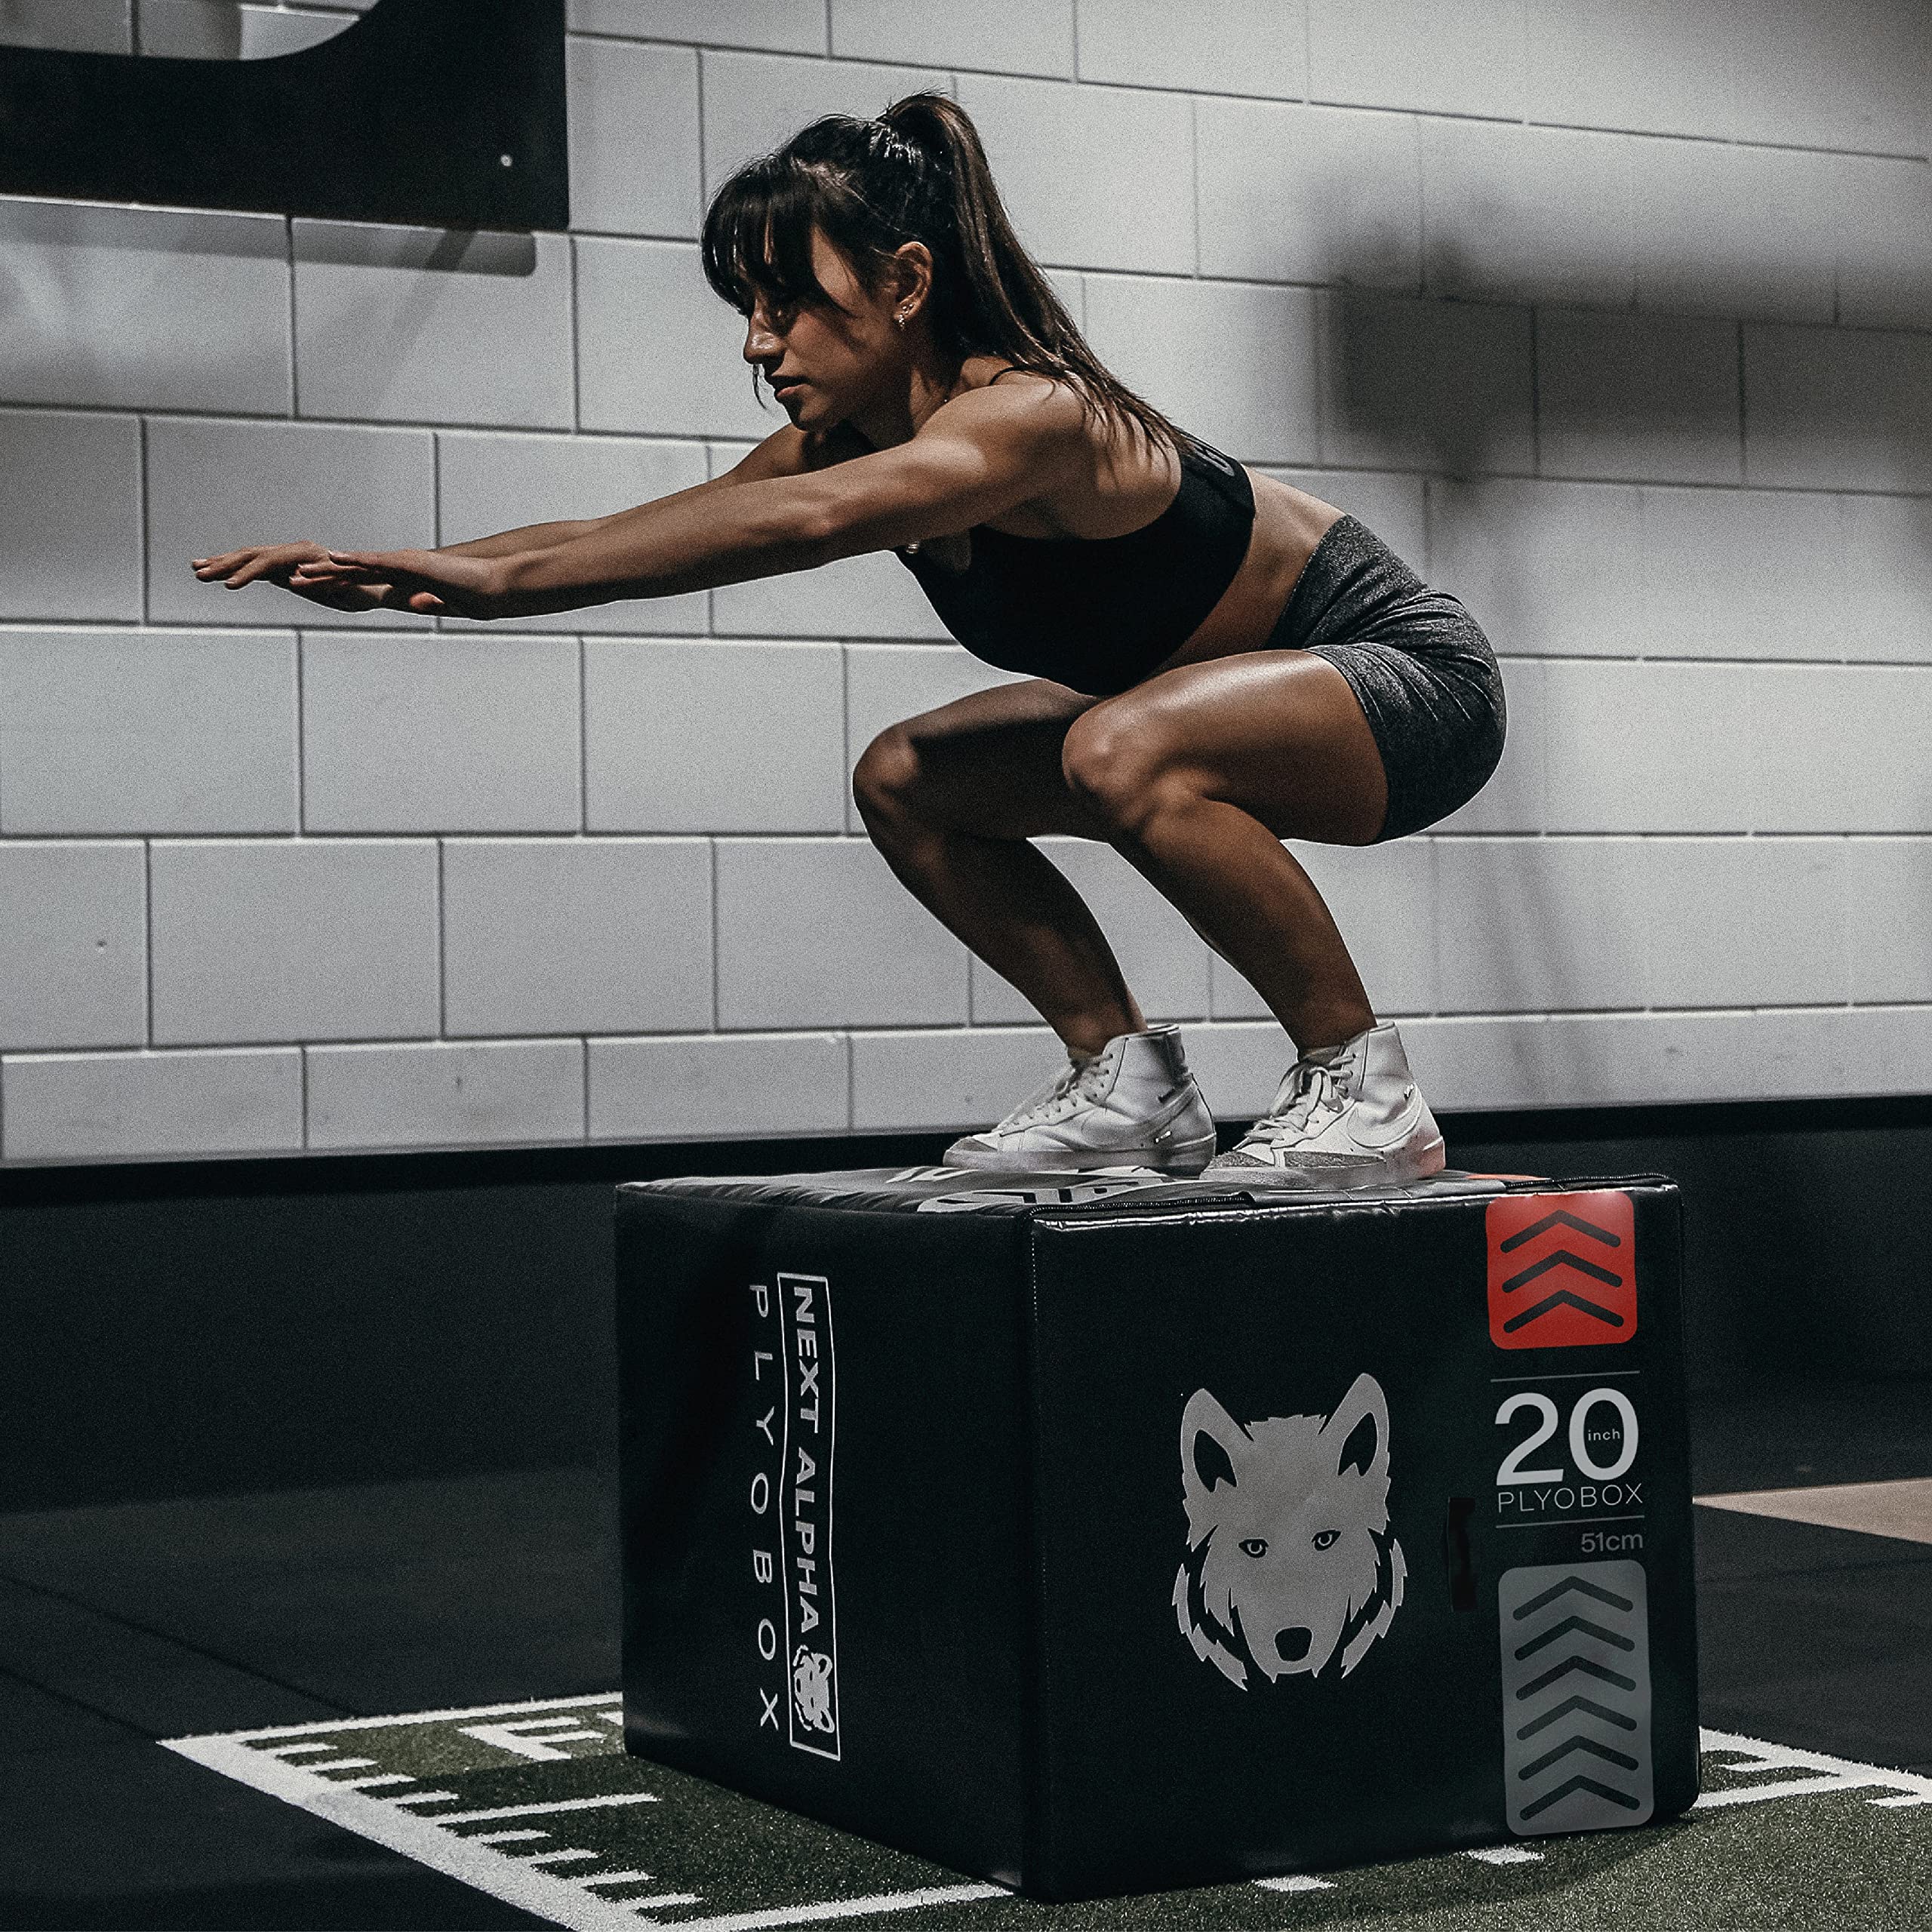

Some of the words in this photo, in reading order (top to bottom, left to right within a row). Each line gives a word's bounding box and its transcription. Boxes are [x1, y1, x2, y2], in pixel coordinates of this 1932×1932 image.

[794, 1287, 818, 1433] NEXT
[1495, 1388, 1638, 1485] 20
[1587, 1429, 1621, 1441] inch
[750, 1285, 779, 1730] PLYOBOX
[795, 1447, 819, 1633] ALPHA
[1498, 1483, 1643, 1512] PLYOBOX
[1581, 1532, 1644, 1552] 51cm
